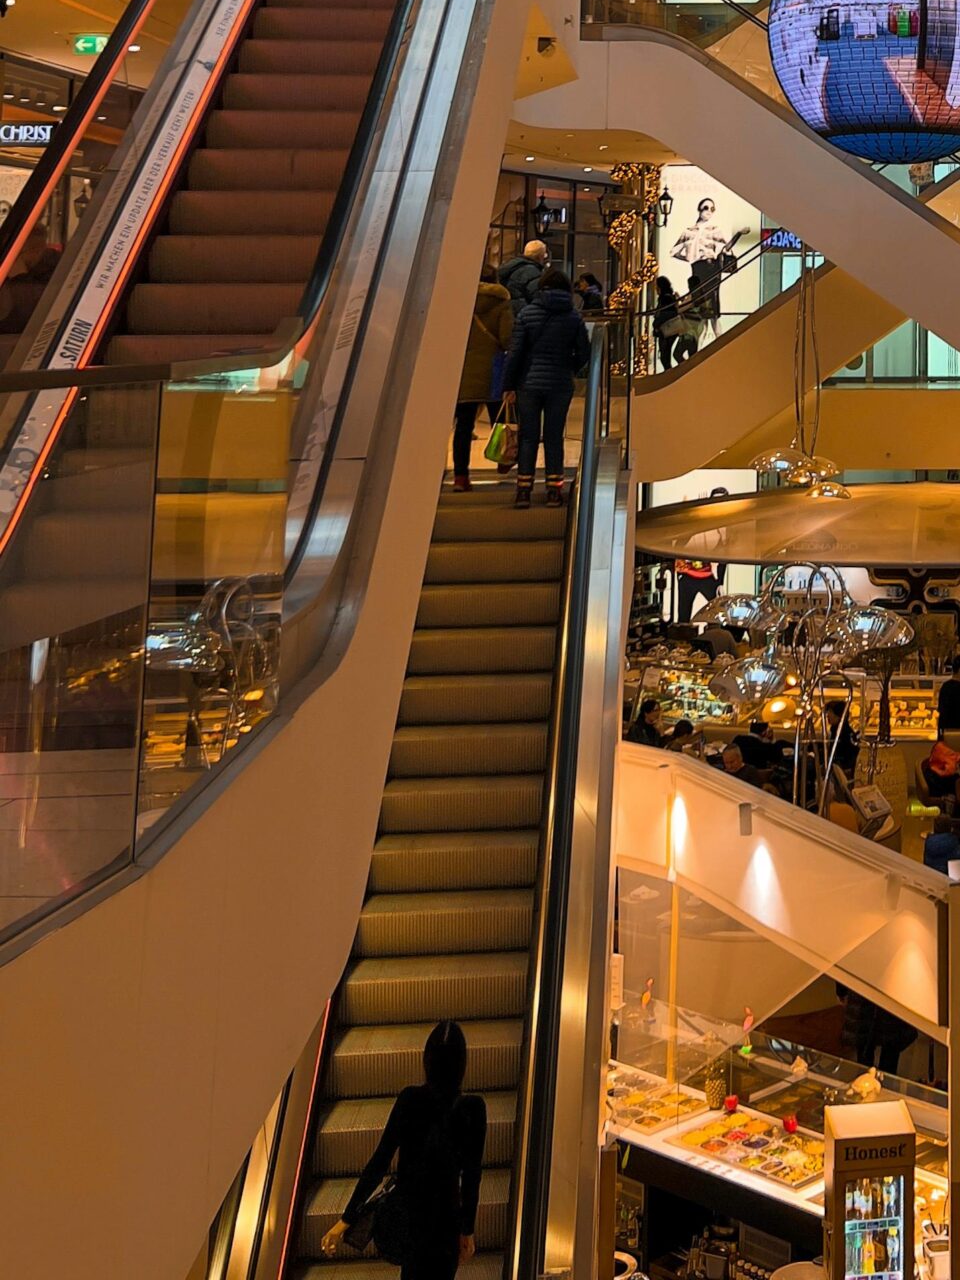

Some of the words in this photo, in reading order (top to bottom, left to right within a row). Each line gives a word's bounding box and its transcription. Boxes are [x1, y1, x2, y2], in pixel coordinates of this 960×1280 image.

[0, 124, 53, 141] CHRIST
[96, 271, 109, 289] WIR
[106, 239, 126, 274] MACHEN
[119, 221, 133, 243] EIN
[127, 191, 147, 226] UPDATE
[141, 171, 156, 195] ABER
[149, 158, 161, 177] DER
[60, 319, 93, 361] SATURN
[844, 1143, 907, 1161] Honest
